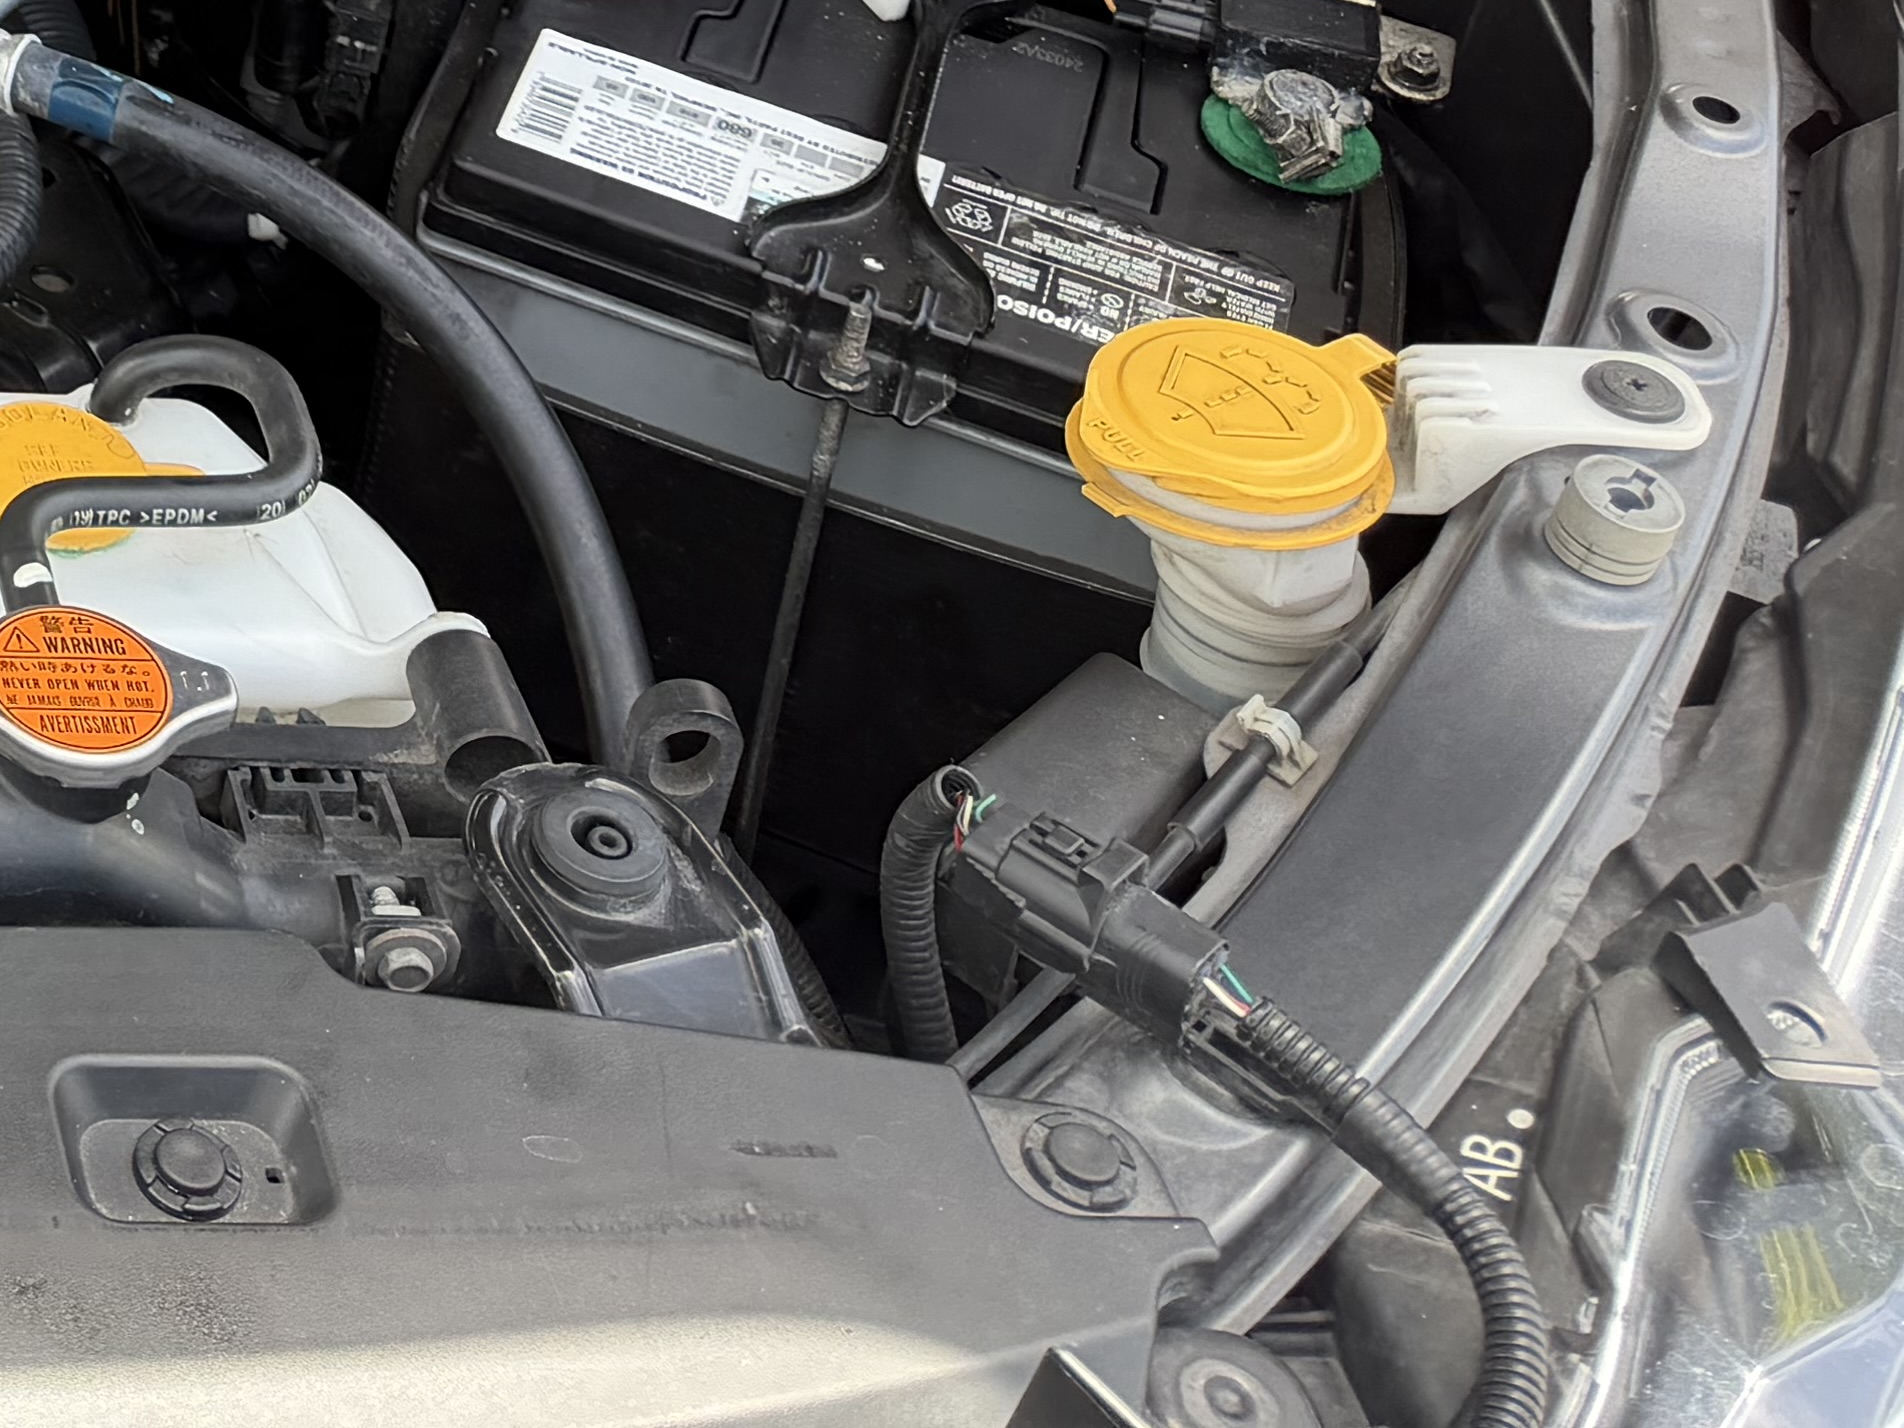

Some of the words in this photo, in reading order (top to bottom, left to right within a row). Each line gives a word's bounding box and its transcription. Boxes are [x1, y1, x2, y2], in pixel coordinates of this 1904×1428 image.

[715, 117, 754, 139] 680
[1235, 270, 1255, 284] OUT
[1256, 277, 1280, 293] KEEP
[995, 292, 1115, 345] ER/POISO
[1085, 415, 1146, 462] PULL
[96, 508, 130, 526] TPC
[139, 505, 217, 526] >EPDM<
[39, 615, 94, 633] 警告
[42, 636, 125, 654] WARNING
[2, 677, 41, 688] NEVER
[47, 678, 79, 689] OPEN
[84, 679, 119, 690] WHEN
[126, 680, 154, 692] HOT.
[1458, 1132, 1523, 1201] AB
